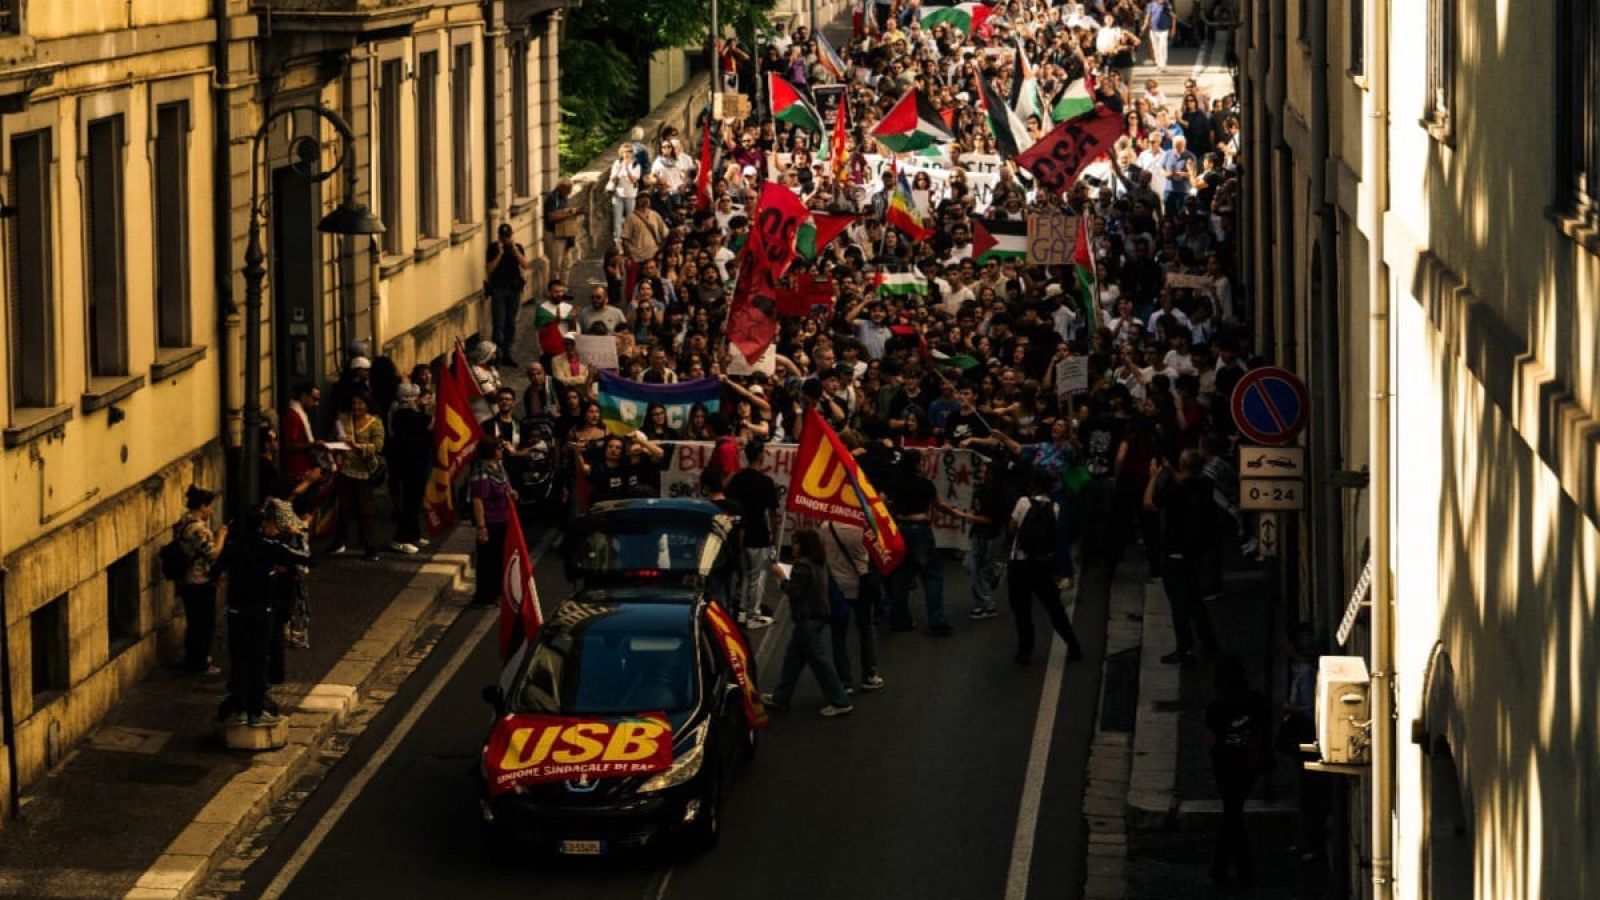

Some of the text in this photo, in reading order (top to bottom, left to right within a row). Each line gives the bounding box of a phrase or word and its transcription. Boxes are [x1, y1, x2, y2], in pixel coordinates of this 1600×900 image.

[1035, 215, 1080, 239] FRE
[1031, 238, 1077, 263] GAZ
[499, 722, 661, 770] USB
[497, 767, 541, 785] UNIONE
[543, 763, 607, 776] SINDACALE
